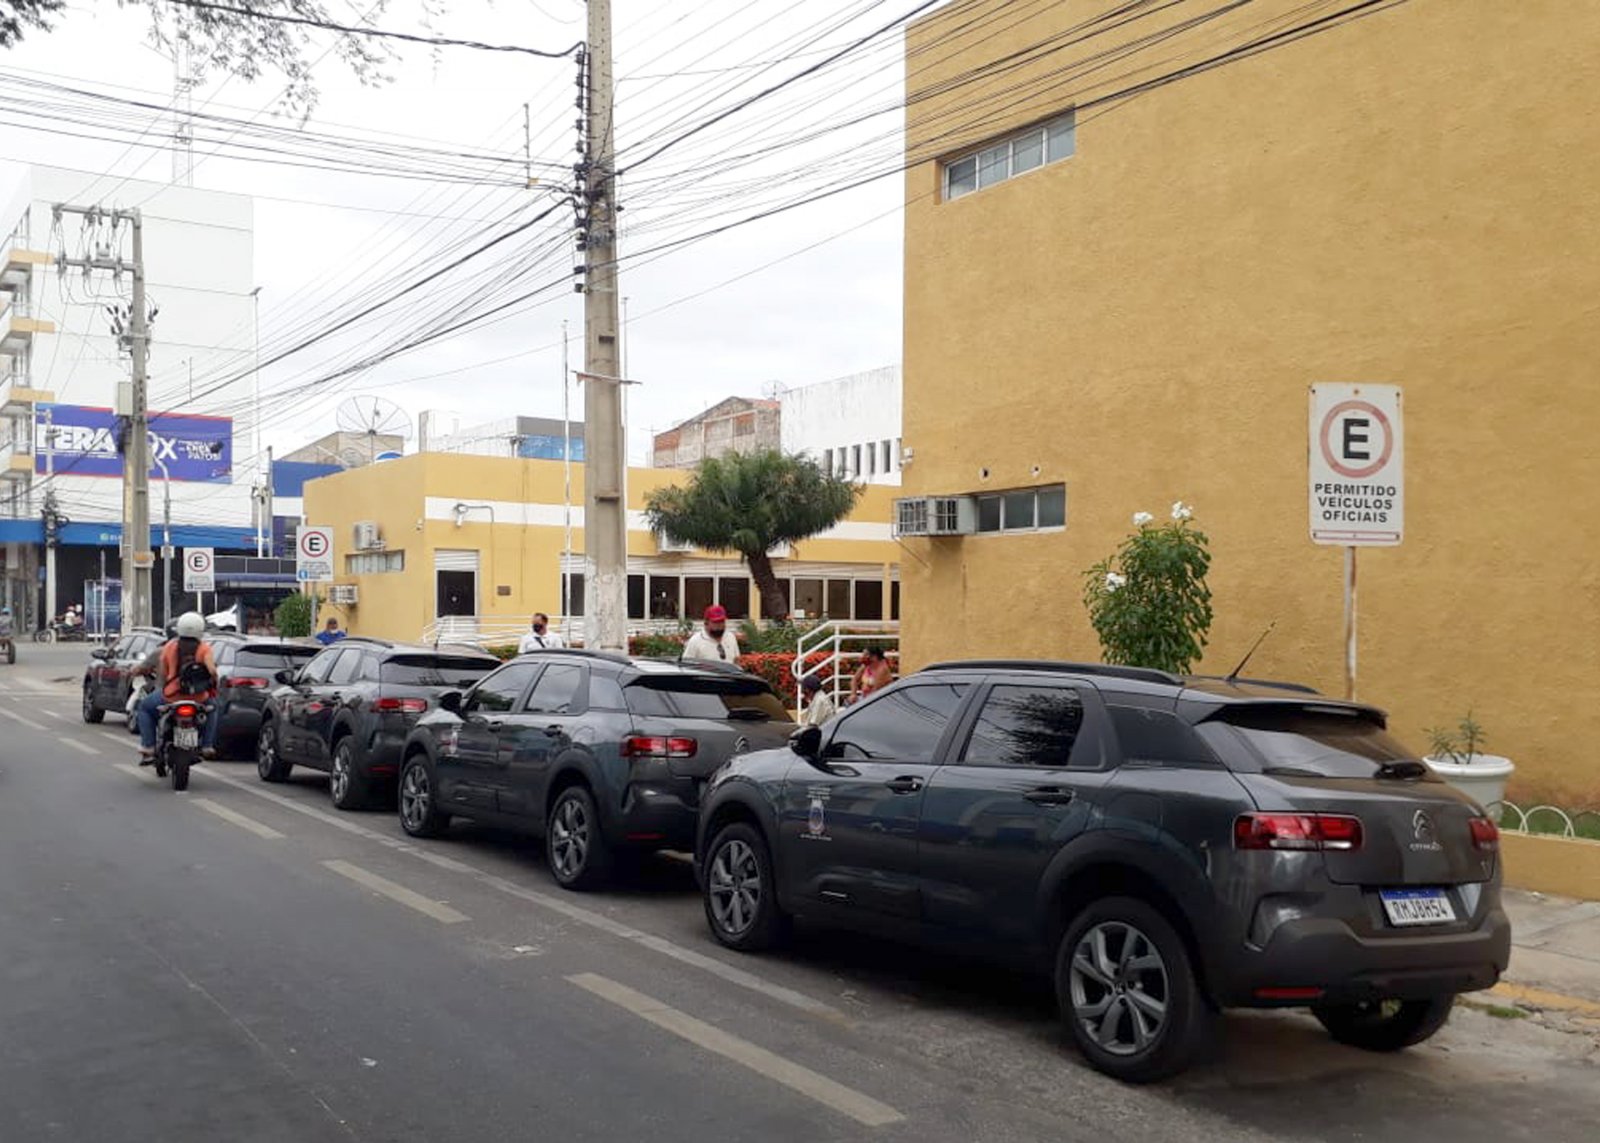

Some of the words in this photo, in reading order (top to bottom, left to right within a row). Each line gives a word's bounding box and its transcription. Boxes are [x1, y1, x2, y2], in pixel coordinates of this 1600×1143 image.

[1343, 418, 1370, 460] E
[1314, 483, 1396, 497] PERMITIDO
[1317, 496, 1393, 510] VEÍCULOS
[1322, 510, 1388, 523] OFICIAIS
[309, 537, 321, 552] E
[194, 556, 204, 568] E
